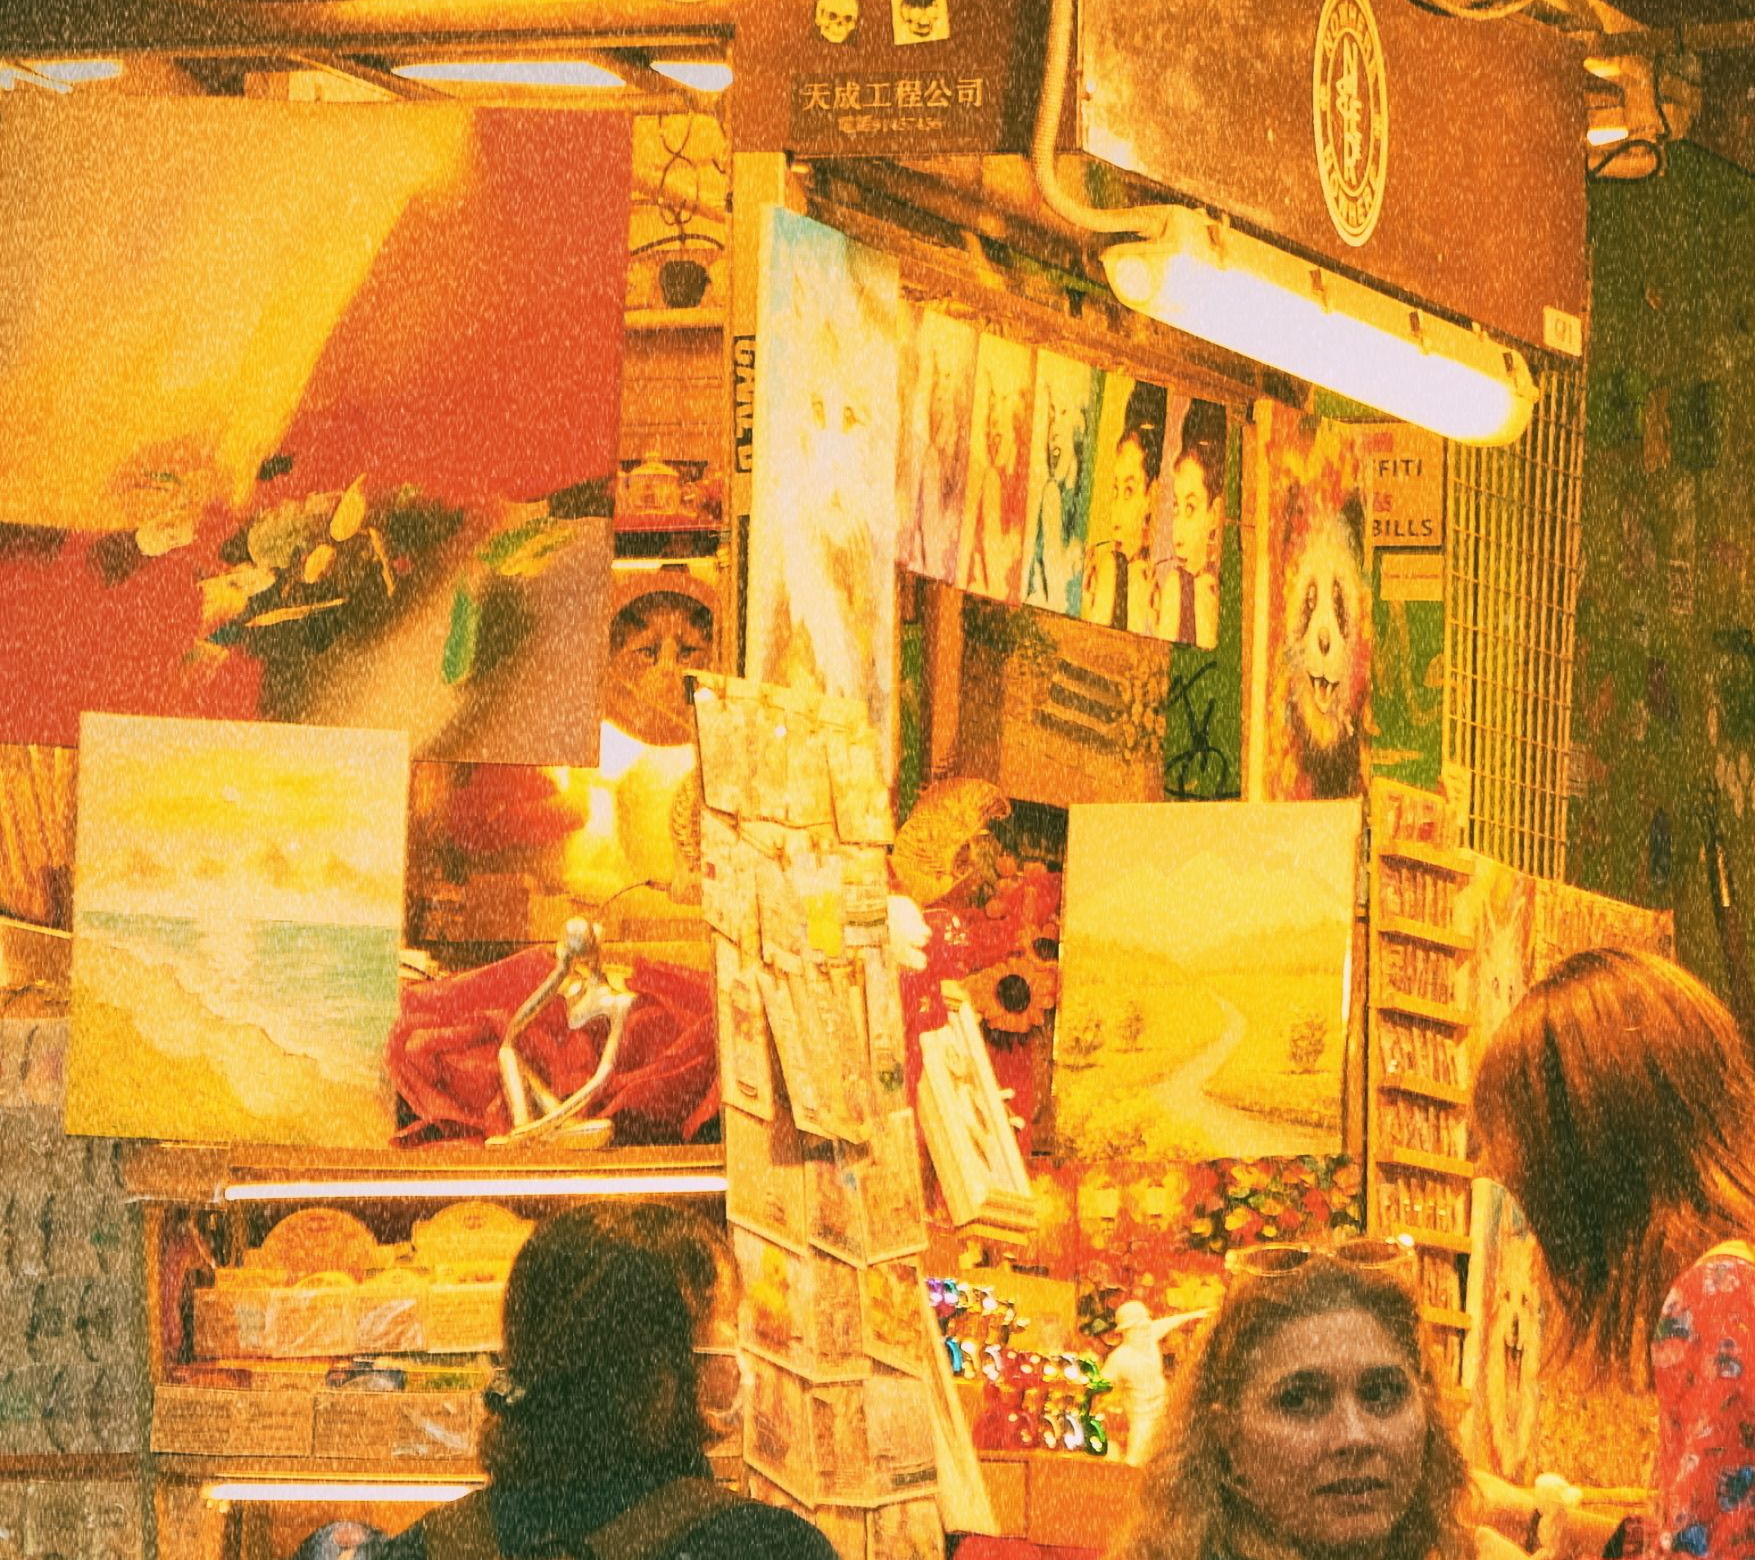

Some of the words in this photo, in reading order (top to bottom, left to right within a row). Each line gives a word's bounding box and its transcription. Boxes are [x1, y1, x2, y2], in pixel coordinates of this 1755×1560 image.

[801, 77, 983, 111] 天成工程公司
